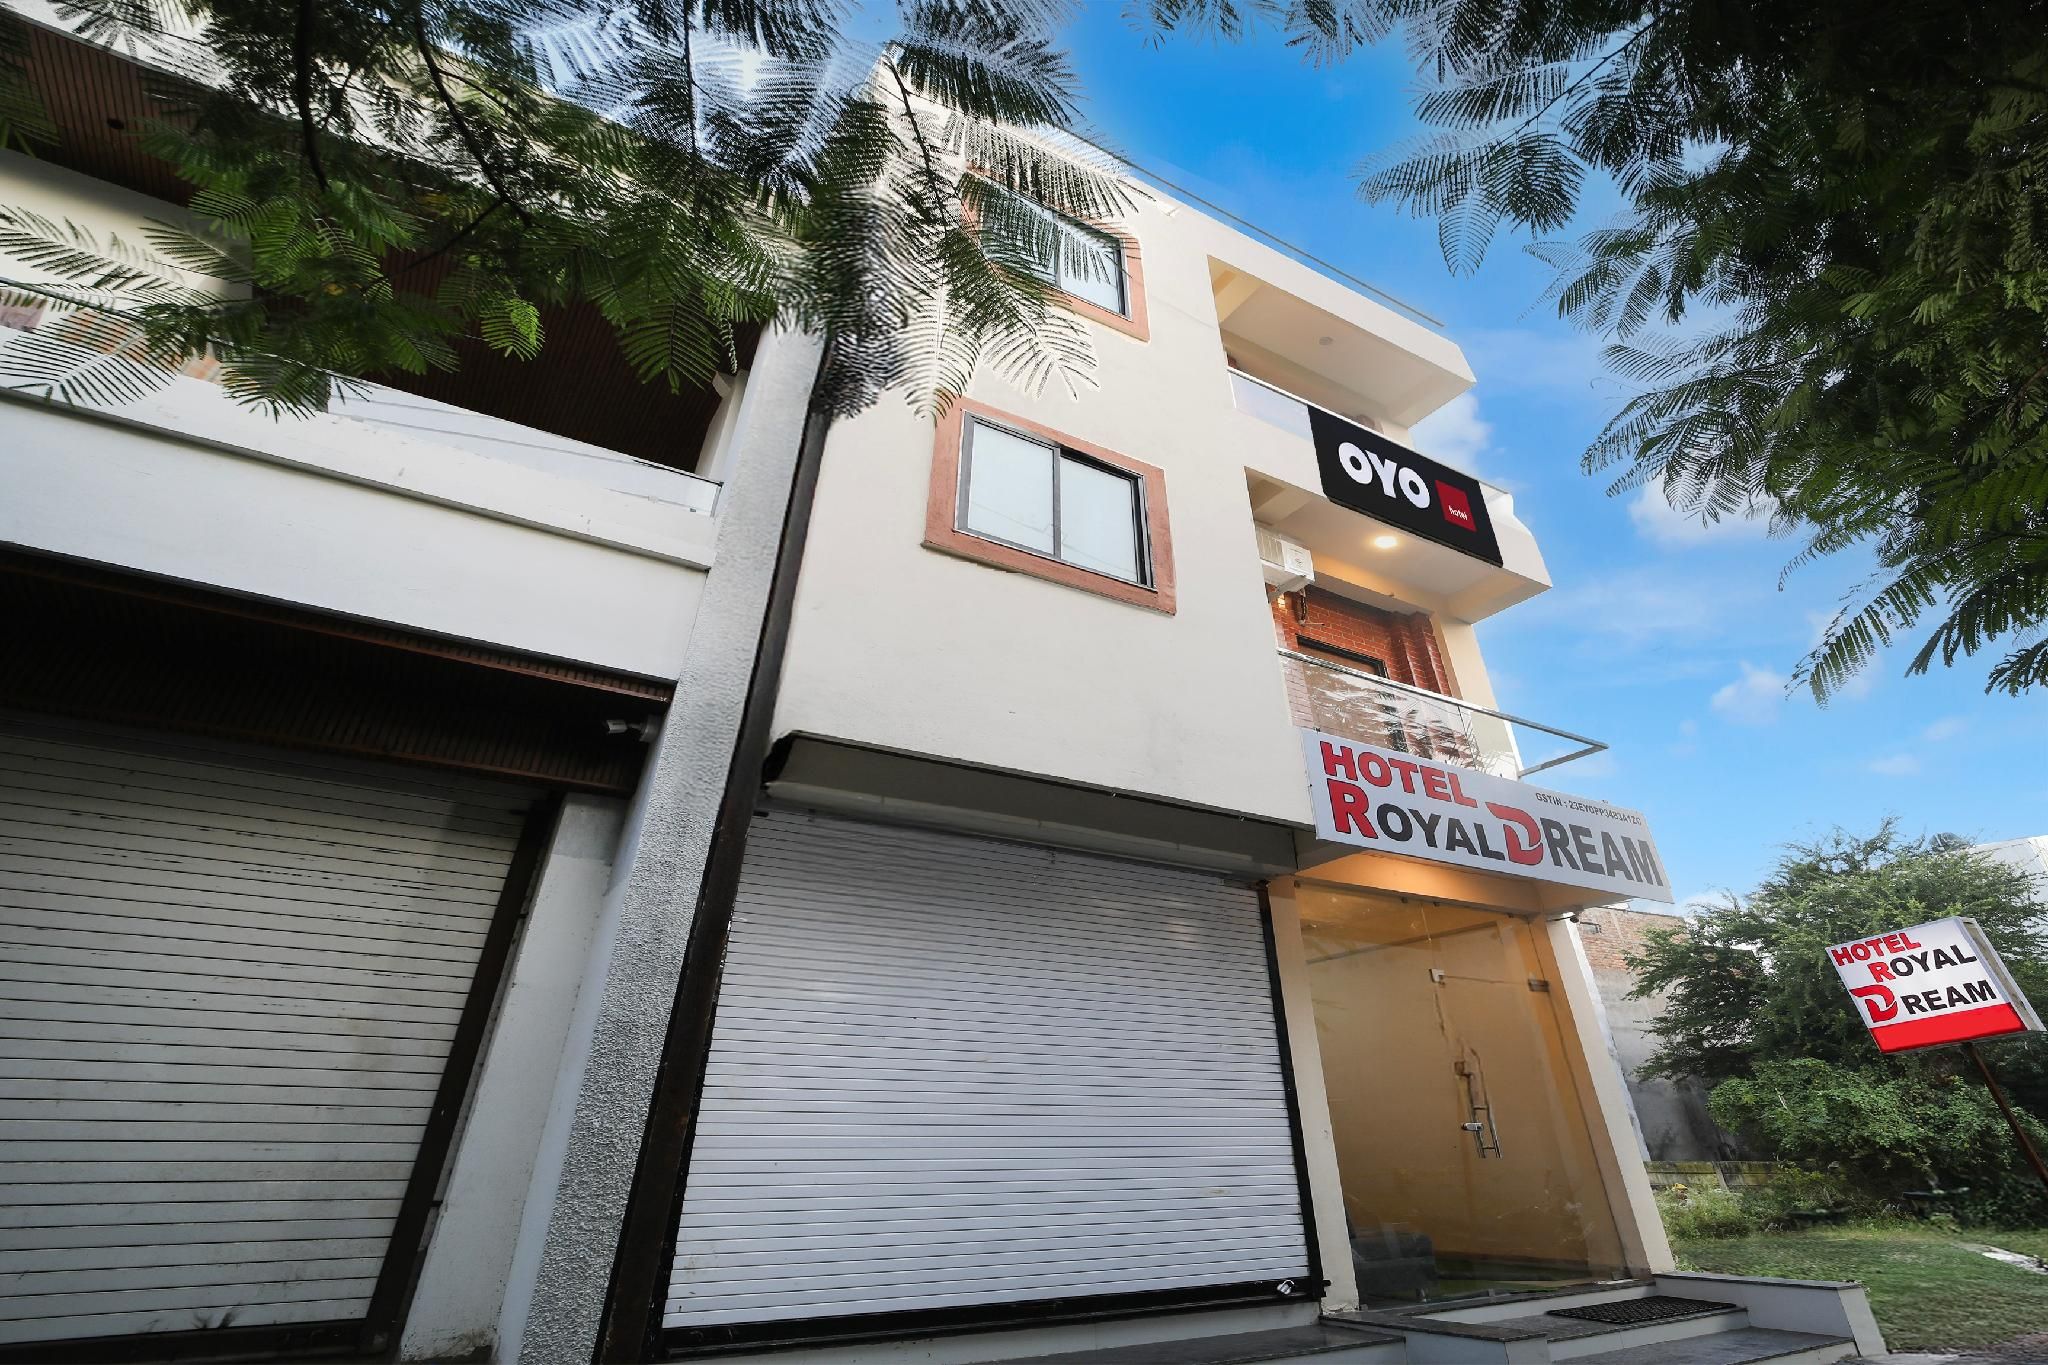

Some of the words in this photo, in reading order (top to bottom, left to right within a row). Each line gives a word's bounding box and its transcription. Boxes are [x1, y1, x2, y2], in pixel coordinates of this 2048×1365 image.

[1338, 442, 1430, 509] OYO
[1319, 740, 1478, 808] HOTEL
[1326, 777, 1506, 861] ROYAL
[1485, 801, 1664, 887] DREAM
[1831, 932, 1921, 967] HOTEL
[1867, 944, 1978, 983] ROYAL
[1849, 979, 1997, 1023] DREAM
